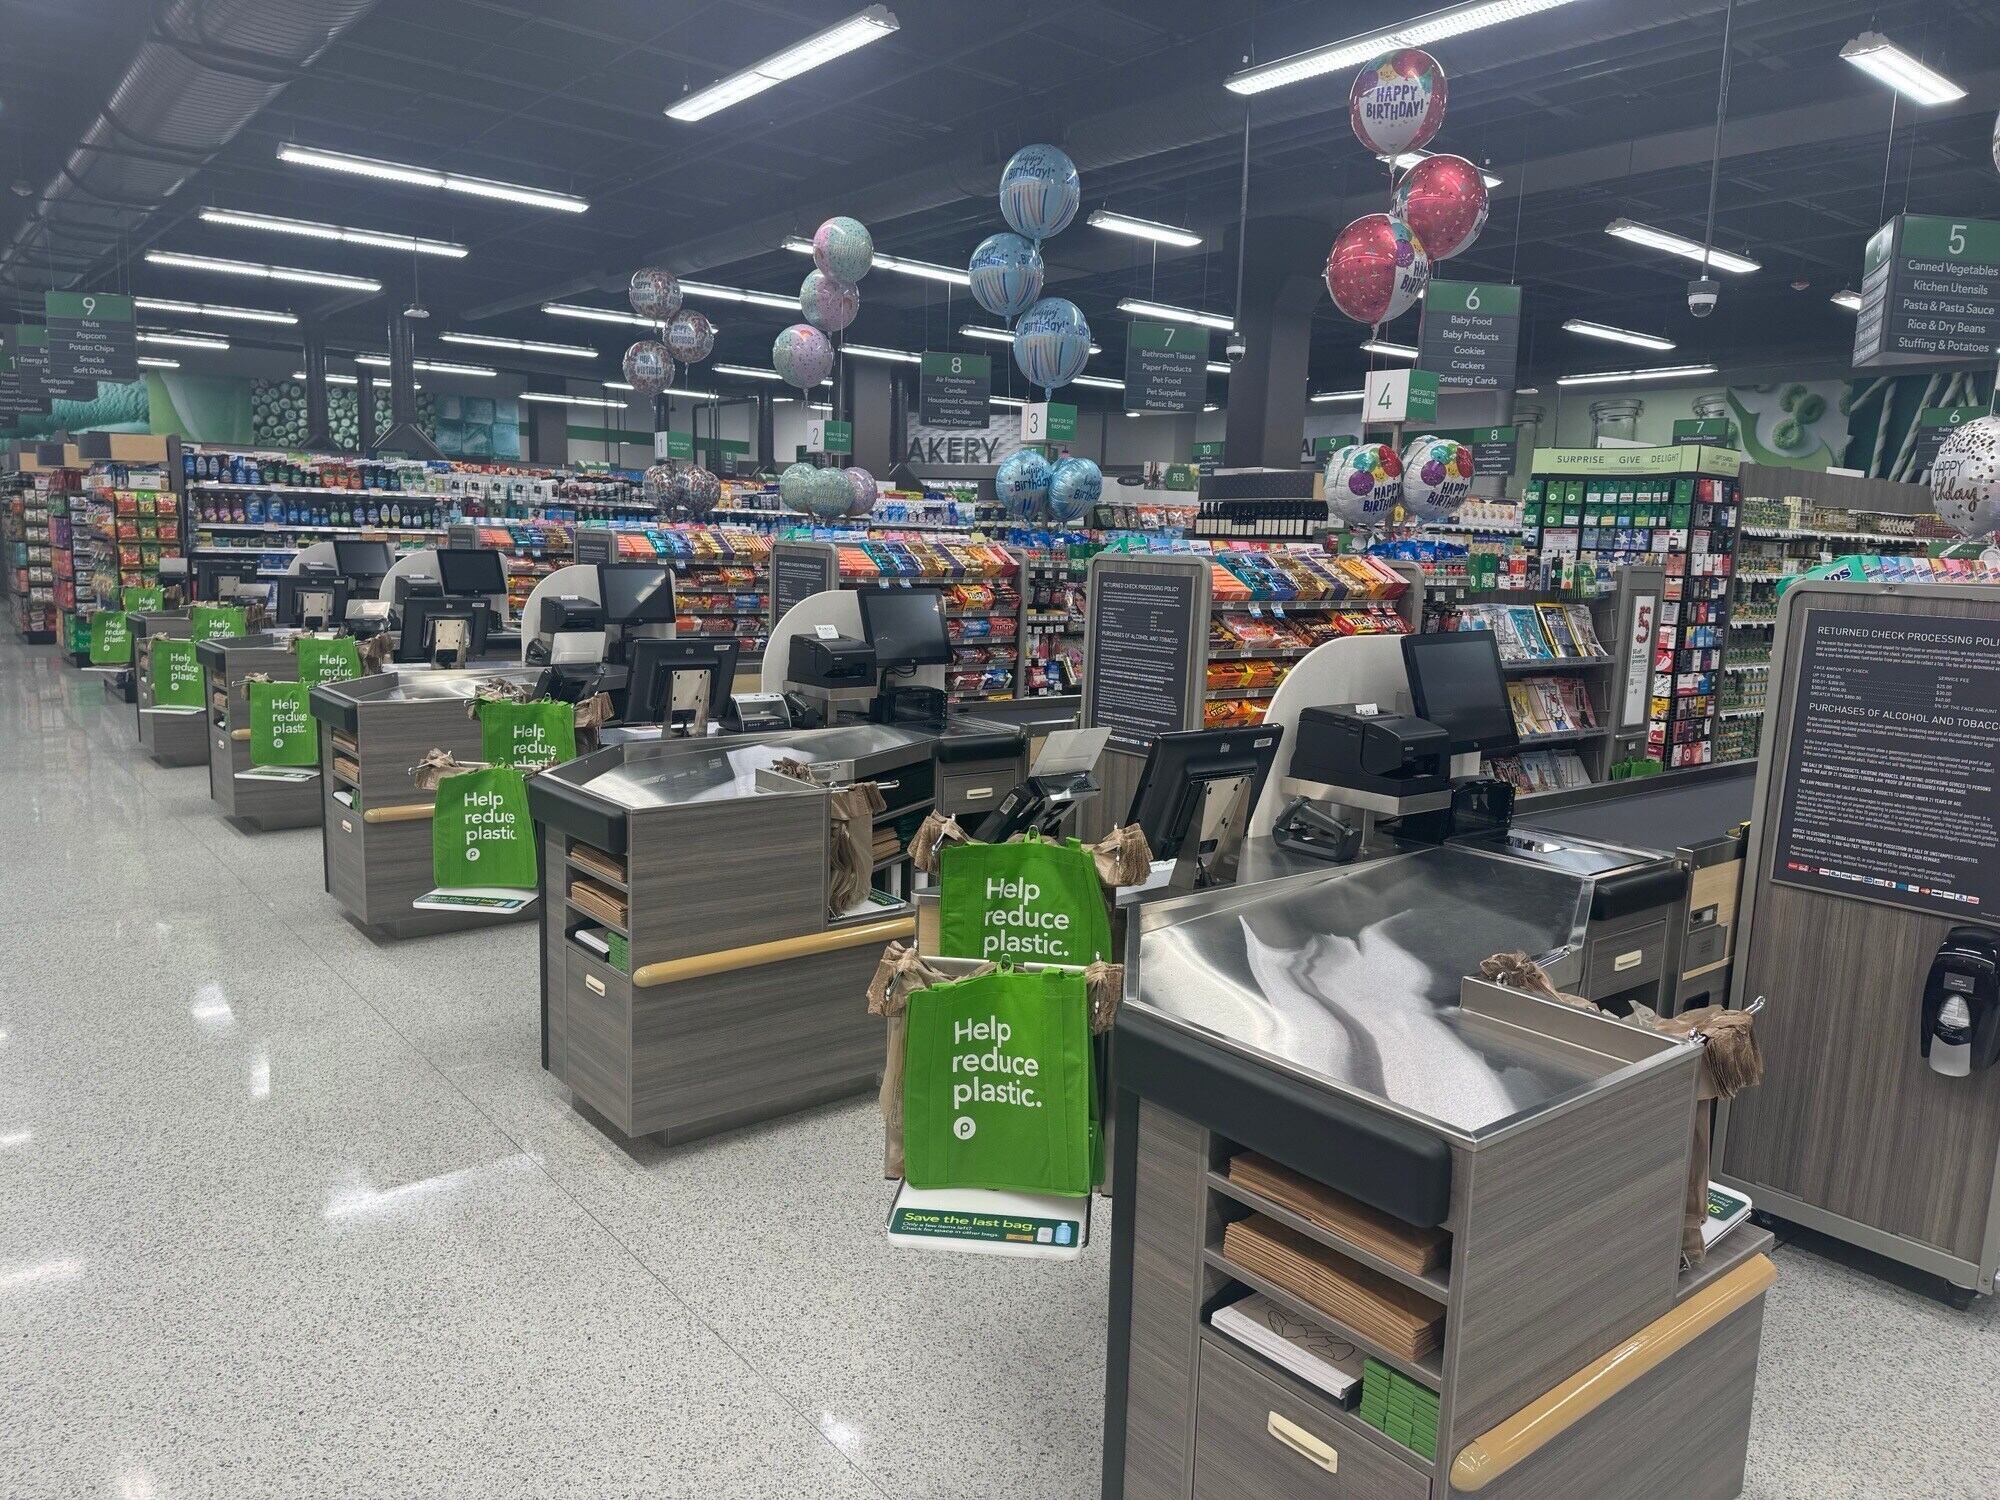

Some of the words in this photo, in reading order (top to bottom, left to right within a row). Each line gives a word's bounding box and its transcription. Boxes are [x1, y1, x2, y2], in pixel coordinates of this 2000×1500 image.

[1376, 85, 1418, 102] HAPPY
[1366, 98, 1424, 120] BIRTHDAY!
[1949, 224, 1968, 254] 5
[1908, 260, 1944, 272] Canned
[1945, 262, 1999, 277] Vegetables
[1914, 280, 1949, 292] Kitchen
[1951, 282, 1989, 295] Utensils
[1466, 288, 1480, 310] 6
[82, 297, 96, 316] 9
[1903, 299, 1928, 311] Pasta
[1929, 301, 1938, 311] &
[1939, 301, 1964, 313] Pasta
[1966, 304, 1995, 315] Sauce
[82, 320, 100, 328] Nuts
[1451, 315, 1470, 326] Baby
[1472, 316, 1492, 326] Food
[1907, 318, 1927, 330] Rice
[1929, 320, 1937, 330] &
[1938, 320, 1955, 334] Dry
[1957, 322, 1986, 333] Beans
[76, 331, 107, 340] Popcorn
[1164, 328, 1175, 347] 7
[1443, 330, 1462, 341] Baby
[1463, 331, 1499, 341] Products
[69, 343, 93, 351] Potato
[94, 343, 115, 353] Chips
[1454, 346, 1486, 356] Cookies
[1898, 337, 1937, 351] Stuffing
[1938, 339, 1946, 350] &
[1948, 340, 1989, 352] Potatoes
[20, 356, 43, 366] Energy
[79, 355, 105, 364] Snacks
[1141, 350, 1175, 359] Bathroom
[1175, 352, 1196, 360] Tissue
[72, 366, 89, 375] Soft
[89, 367, 113, 376] Drinks
[951, 357, 962, 373] 8
[1142, 363, 1161, 372] Paper
[1162, 364, 1192, 373] Products
[1451, 361, 1485, 370] Crackers
[945, 376, 976, 385] Fresheners
[1165, 377, 1182, 385] Food
[1439, 375, 1473, 386] Greeting
[1474, 376, 1497, 385] Cards
[1146, 388, 1157, 396] Pet
[1159, 389, 1186, 398] Supplies
[1377, 382, 1392, 410] 4
[959, 398, 983, 406] Cleaners
[1146, 400, 1166, 408] Plastic
[1168, 401, 1184, 410] Bags
[928, 417, 951, 426] Laundry
[952, 418, 982, 427] Detergent
[1030, 413, 1038, 433] 3
[1950, 410, 1961, 423] 6
[1696, 421, 1704, 433] 7
[812, 427, 819, 446] 2
[1491, 429, 1498, 440] 8
[1203, 445, 1211, 454] 10
[1330, 438, 1337, 448] 9
[907, 437, 999, 464] AKERY
[1557, 455, 1605, 464] SURPRISE
[1619, 456, 1641, 464] GIVE
[1651, 453, 1679, 463] DELIGHT
[1374, 482, 1401, 499] HAPPY
[1440, 482, 1468, 496] HAPPY
[1933, 477, 1982, 513] thday
[1363, 495, 1400, 512] BIRTHD
[1426, 491, 1461, 509] BIRTHD
[209, 619, 230, 631] Help
[1818, 626, 1869, 637] RETURNED
[1871, 630, 1905, 640] CHECK
[1907, 632, 1973, 645] PROCESSING
[1975, 636, 2000, 647] POLI
[170, 653, 191, 665] Help
[320, 655, 348, 667] Help
[320, 666, 352, 677] reduc
[271, 699, 300, 711] Help
[1809, 702, 1865, 716] PURCHASES
[1867, 709, 1881, 717] OF
[1882, 711, 1929, 723] ALCOHOL
[1931, 716, 1954, 726] AND
[1956, 718, 2000, 731] TOBACC
[513, 724, 545, 741] Help
[464, 791, 503, 809] Help
[986, 877, 1041, 908] Help
[983, 905, 1070, 931] reduce
[983, 929, 1070, 957] plastic.
[953, 1015, 1012, 1049] Help
[952, 1045, 1040, 1078] reduce
[952, 1077, 1043, 1110] plastic.
[903, 1213, 940, 1223] Save
[944, 1215, 970, 1225] the
[973, 1217, 1000, 1228] last
[1003, 1220, 1037, 1231] bag.
